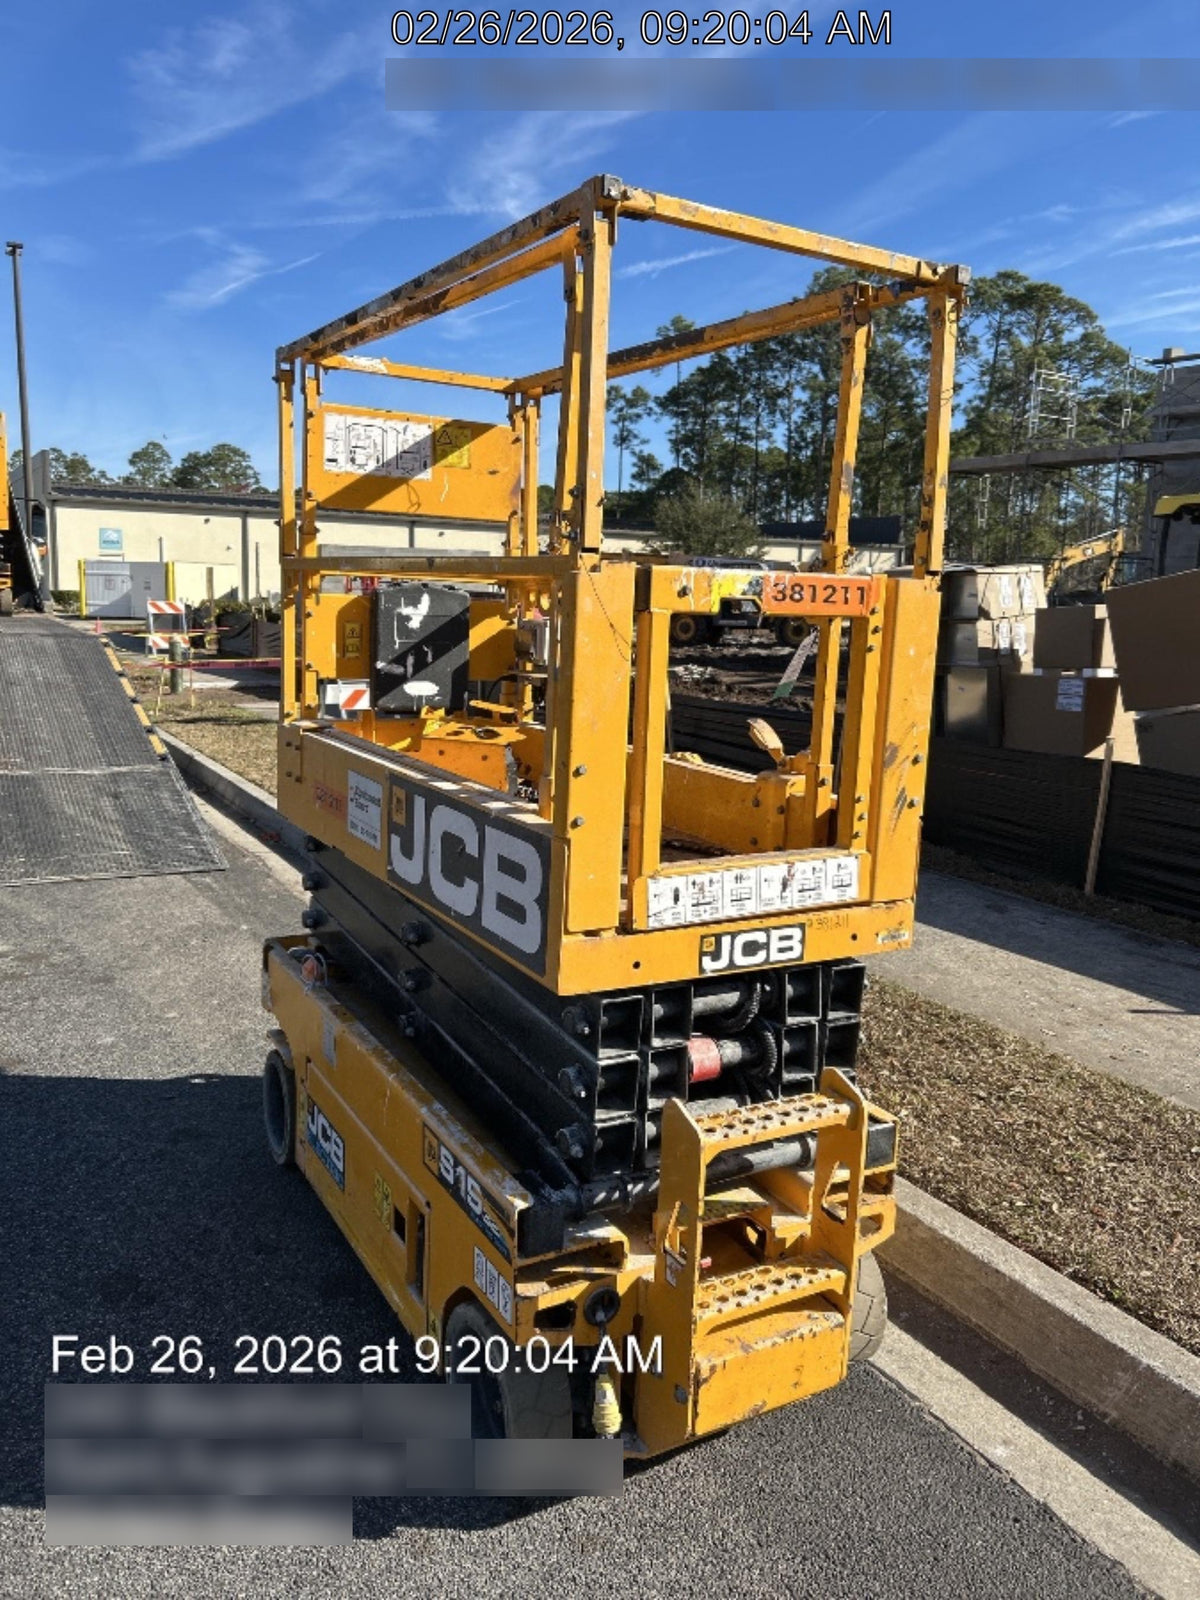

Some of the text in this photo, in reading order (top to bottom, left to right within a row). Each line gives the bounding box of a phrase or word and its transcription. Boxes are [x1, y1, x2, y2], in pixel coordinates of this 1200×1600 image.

[771, 582, 866, 605] 381211
[390, 794, 543, 954] JCB
[702, 926, 803, 977] JCB
[307, 1104, 344, 1173] JCB
